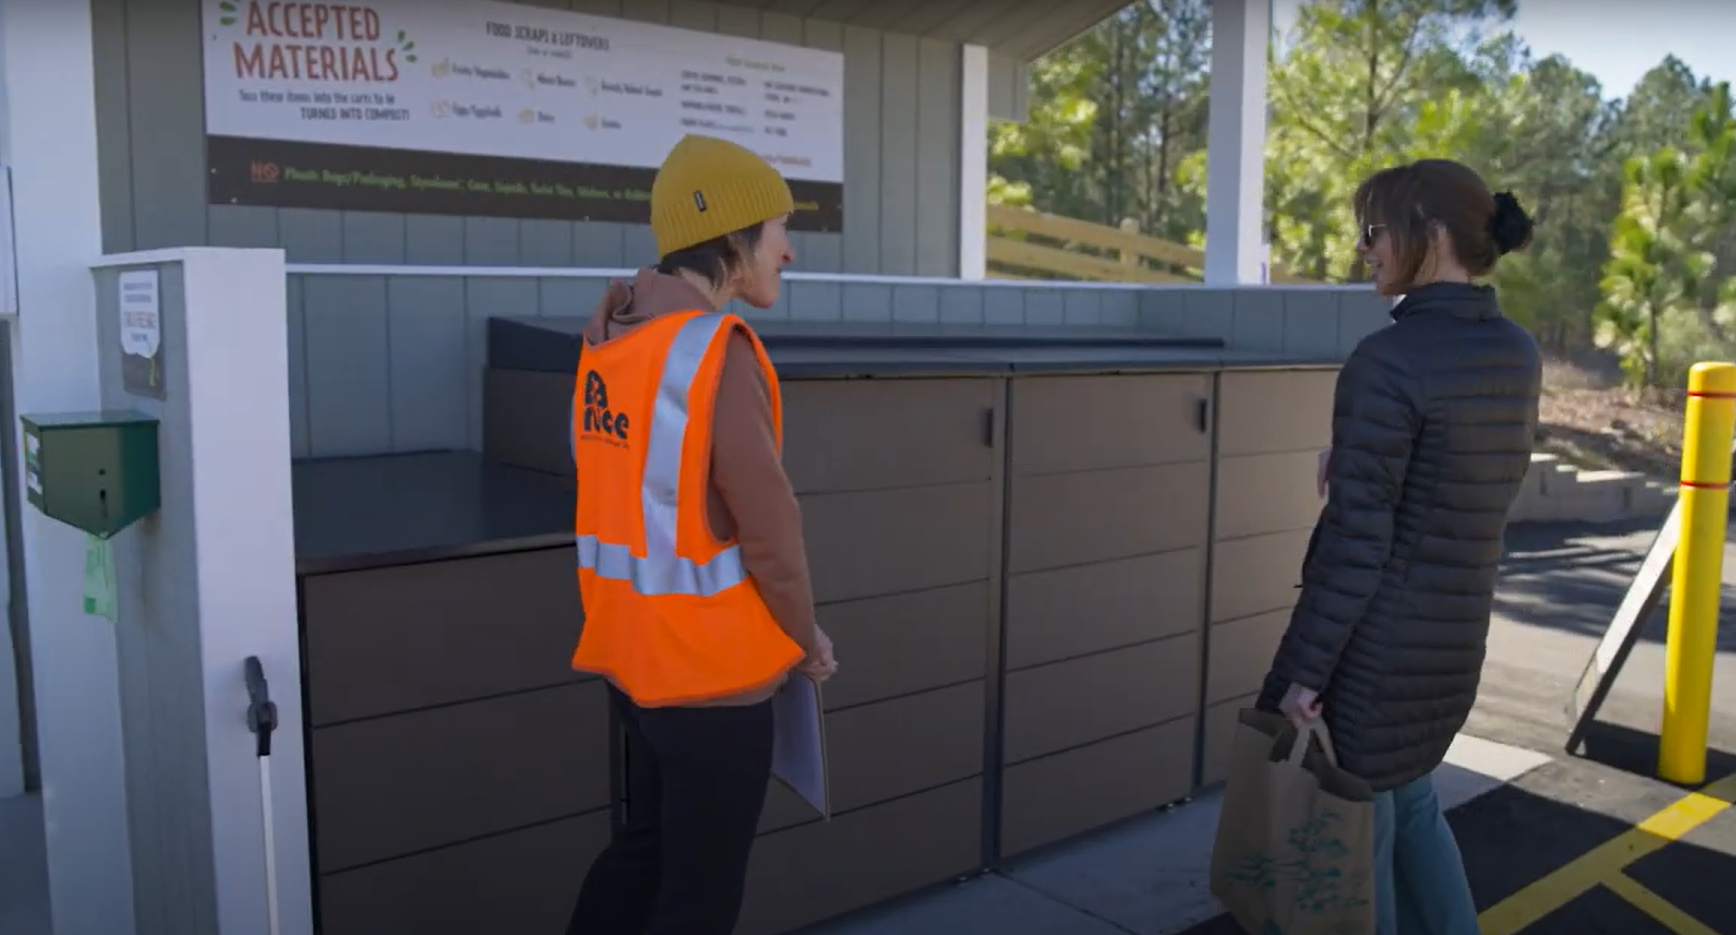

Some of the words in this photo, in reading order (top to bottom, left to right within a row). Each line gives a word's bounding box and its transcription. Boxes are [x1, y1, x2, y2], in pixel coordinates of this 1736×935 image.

[247, 1, 380, 42] ACCEPTED
[486, 21, 512, 38] FOOD
[514, 25, 549, 44] SCRAPS
[559, 33, 610, 51] LEFTOVERS
[233, 42, 399, 82] MATERIALS
[259, 90, 284, 104] these
[313, 92, 332, 105] into
[334, 92, 348, 105] the
[374, 93, 384, 105] to
[301, 107, 337, 121] TURNED
[340, 107, 363, 121] INTO
[250, 161, 280, 183] NO
